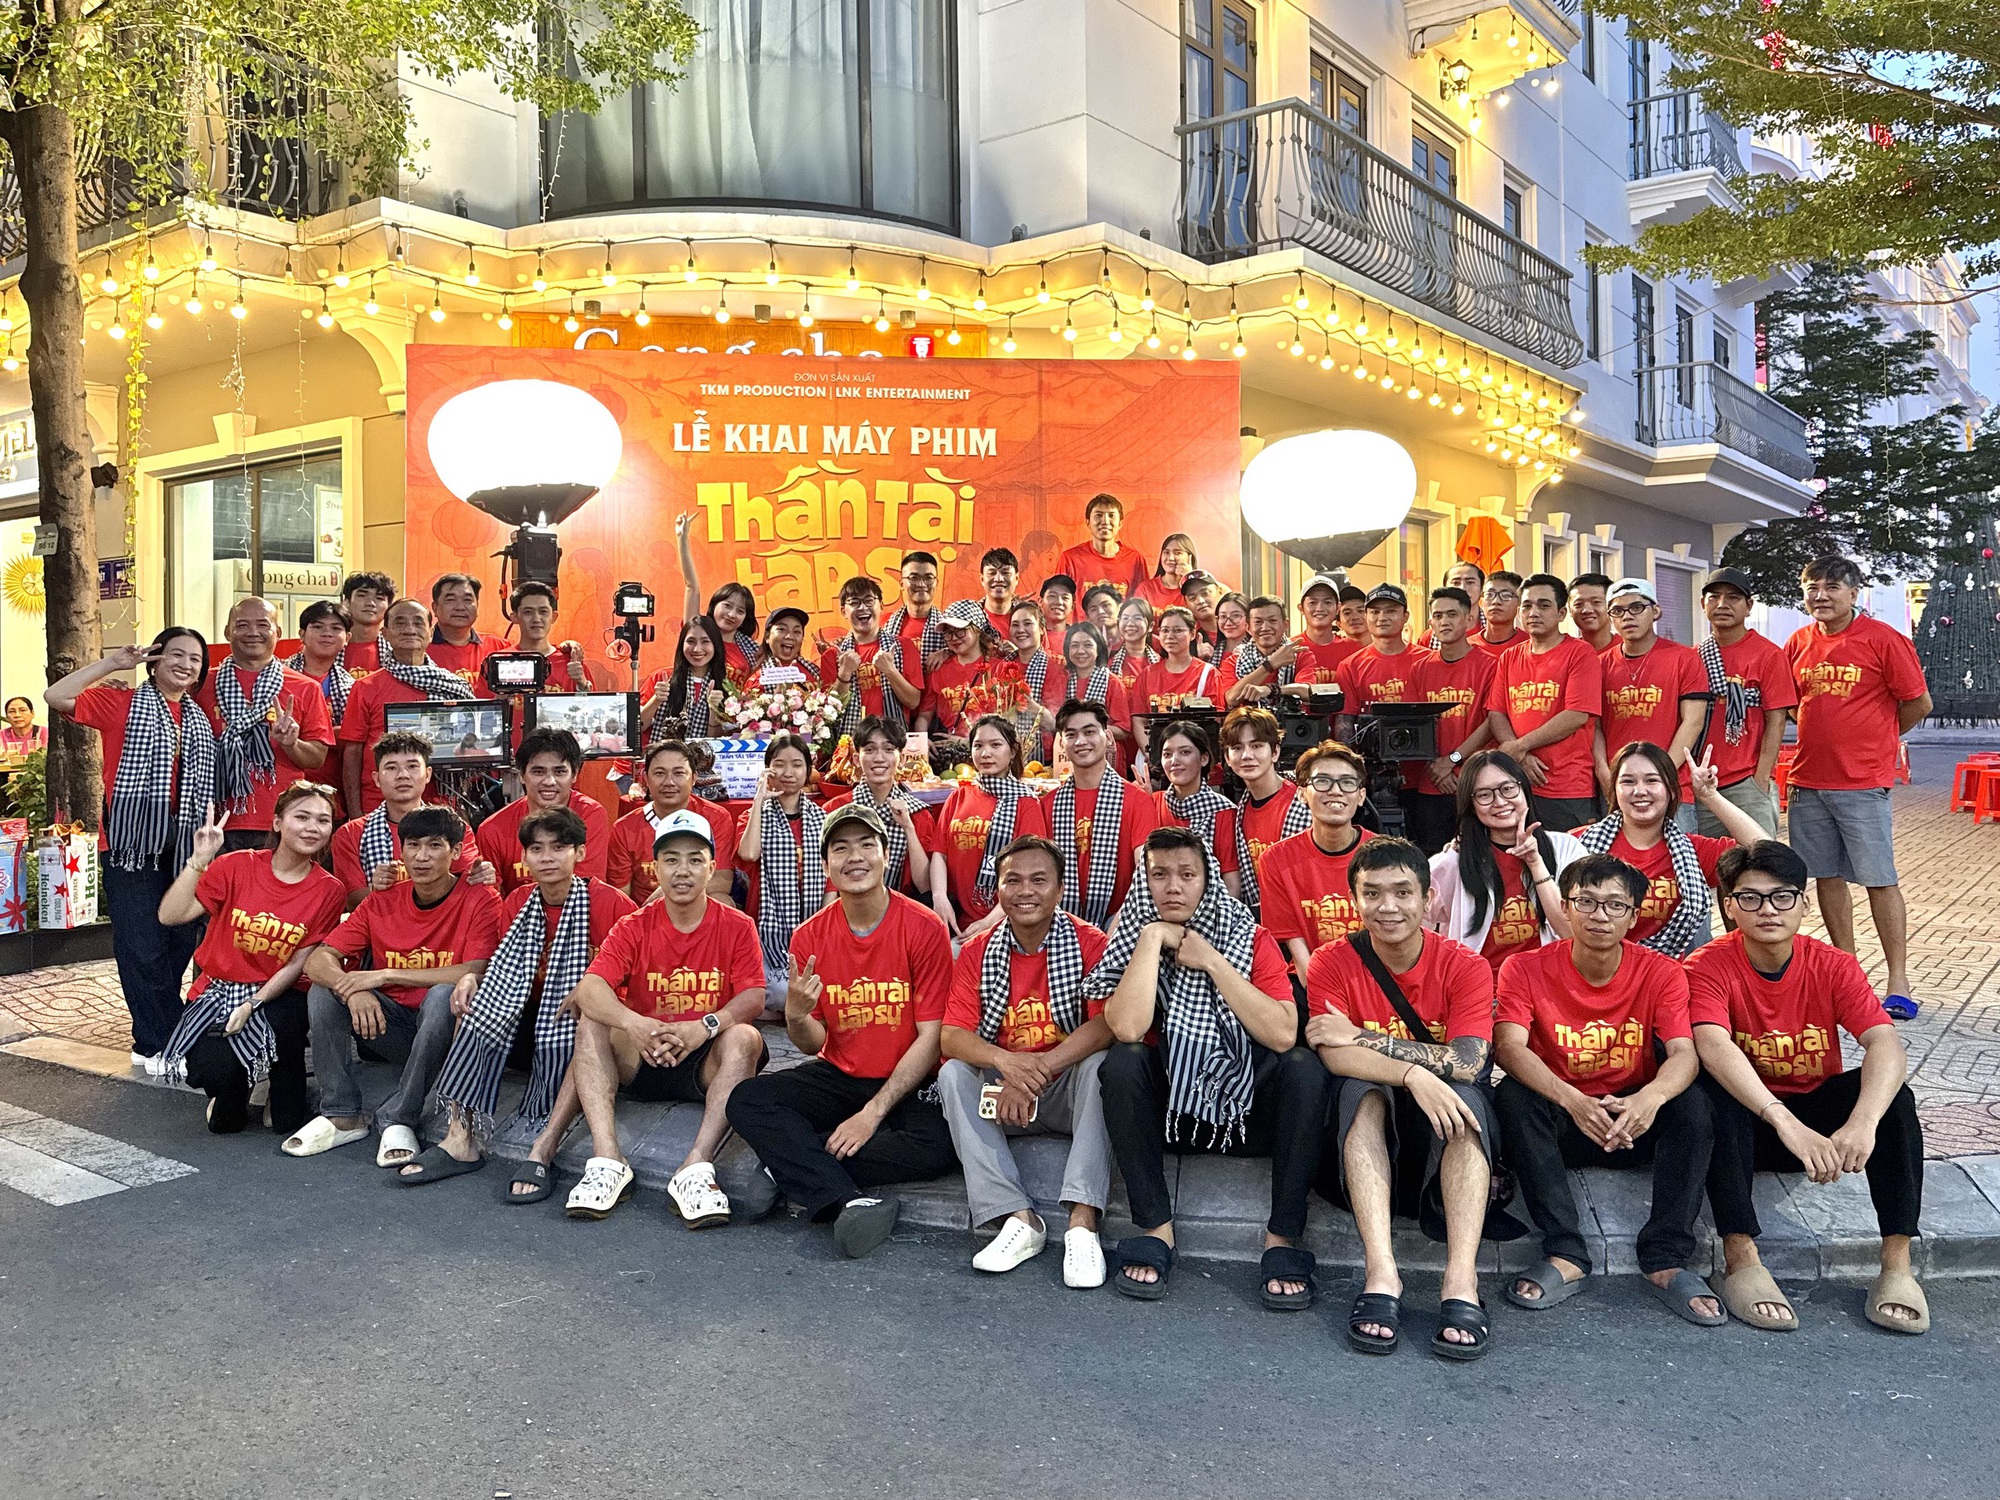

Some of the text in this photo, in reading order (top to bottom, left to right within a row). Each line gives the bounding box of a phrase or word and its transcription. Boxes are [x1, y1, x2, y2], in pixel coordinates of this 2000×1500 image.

[794, 371, 876, 384] ĐƠN VỊ SẢN XUẤT
[700, 384, 971, 400] TKM PRODUCTION LNK ENTERTAINMENT
[673, 409, 997, 462] LỄ KHAI MÁY PHIM
[297, 570, 327, 586] cha
[41, 873, 50, 924] Heineken
